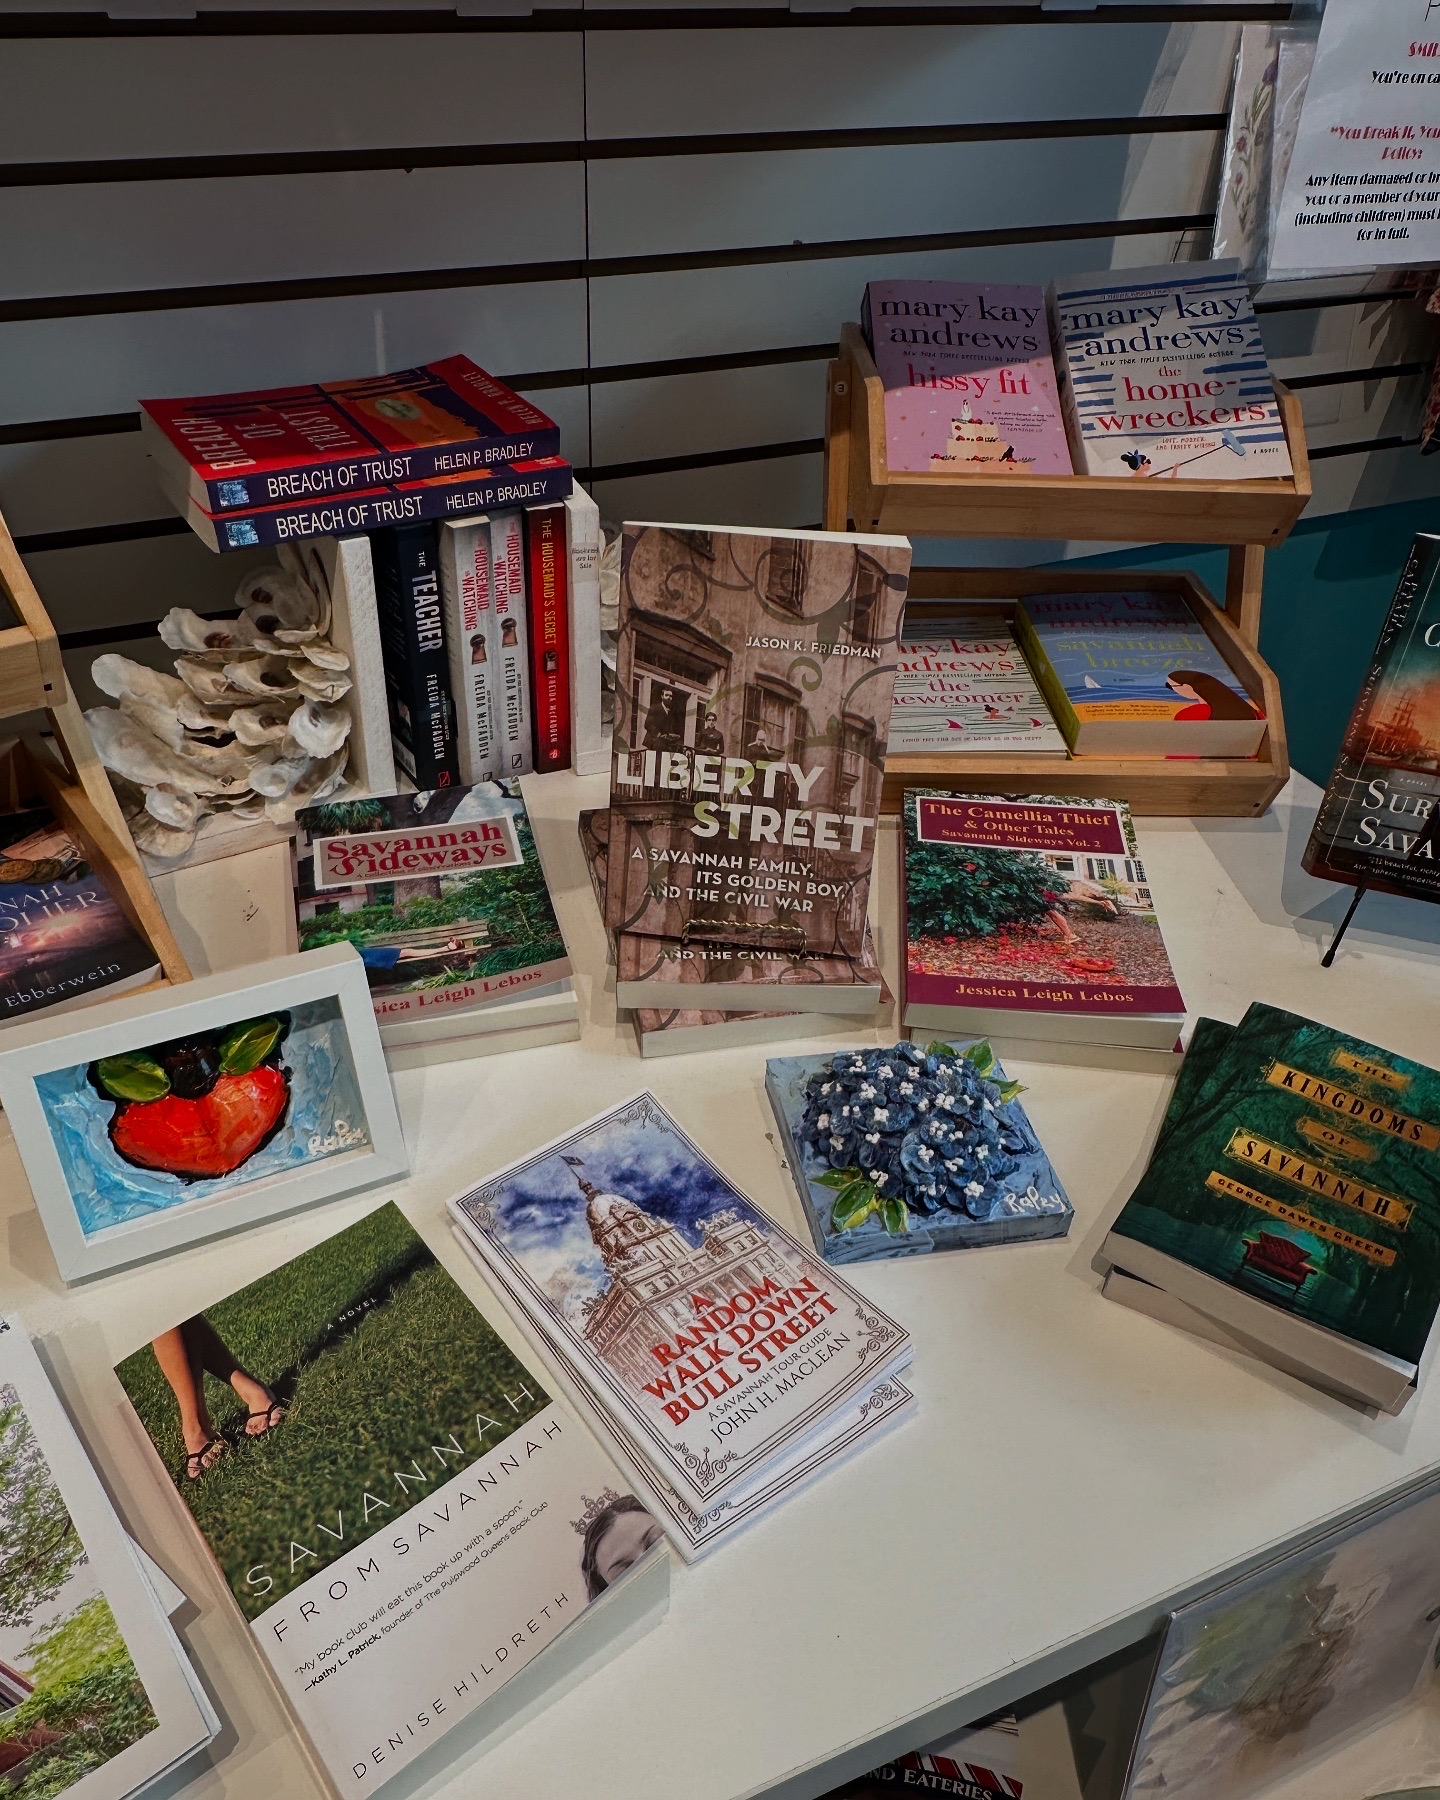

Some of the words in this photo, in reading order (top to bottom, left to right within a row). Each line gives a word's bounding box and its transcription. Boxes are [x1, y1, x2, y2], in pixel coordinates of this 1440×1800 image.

[1372, 71, 1409, 84] You're
[1411, 74, 1426, 83] on
[1363, 126, 1401, 139] Break
[1382, 147, 1423, 160] Policy:
[1305, 175, 1329, 187] Any
[1360, 172, 1413, 185] damaged
[1415, 173, 1427, 184] or
[1306, 195, 1326, 206] you
[1329, 194, 1341, 205] or
[1343, 194, 1350, 204] a
[1352, 191, 1402, 204] member
[1403, 190, 1415, 202] of
[1415, 191, 1440, 202] your
[1295, 211, 1353, 226] (including
[1354, 209, 1405, 222] children)
[1407, 207, 1435, 220] must
[1357, 228, 1373, 241] for
[1374, 227, 1386, 240] in
[1388, 227, 1410, 239] full.
[878, 299, 970, 323] mary
[977, 296, 1042, 328] kay
[1069, 305, 1167, 330] mary
[1172, 294, 1247, 320] kay
[890, 322, 1039, 351] andrews
[1085, 327, 1244, 357] andrews
[907, 363, 990, 399] hissy
[998, 369, 1032, 395] fit
[1158, 366, 1182, 377] the
[1122, 376, 1237, 402] home-
[234, 423, 286, 439] OF
[280, 409, 359, 450] TRUST
[1095, 401, 1266, 431] wreckers
[171, 416, 257, 470] BREACH
[267, 469, 334, 498] BREACH
[337, 465, 359, 486] OF
[362, 457, 412, 479] TRUST
[434, 452, 471, 471] HELEN
[473, 451, 482, 464] P.
[485, 442, 534, 462] BRADLEY
[276, 508, 345, 538] BREACH
[347, 505, 368, 526] OF
[372, 496, 423, 522] TRUST
[446, 492, 484, 511] HELEN
[486, 490, 495, 504] P.
[498, 481, 548, 502] BRADLEY
[542, 519, 552, 539] THE
[418, 551, 426, 567] THE
[506, 534, 521, 594] HOUSEMAID
[541, 542, 555, 607] HOUSEMAID'S
[474, 549, 490, 611] HOUSEMAID
[494, 560, 509, 615] WATCHING
[412, 570, 443, 653] TEACHER
[462, 576, 477, 631] WATCHING
[544, 611, 557, 645] SECRET
[745, 636, 790, 651] JASON
[794, 640, 807, 652] K.
[811, 642, 882, 659] FRIEDMAN
[897, 655, 1015, 672] ndrews
[950, 639, 1011, 656] kay
[426, 673, 439, 708] FREIDA
[474, 673, 487, 708] FREIDA
[504, 657, 517, 690] FREIDA
[927, 679, 970, 692] the
[892, 692, 1024, 705] newcomer
[506, 694, 519, 741] McFADDEN
[431, 712, 445, 760] McFADDEN
[477, 711, 489, 760] McFADDEN
[616, 749, 825, 802] LIBERTY
[690, 801, 875, 853] STREET
[925, 803, 963, 816] The
[967, 807, 1053, 823] Camellia
[1057, 812, 1111, 826] Thief
[963, 820, 978, 829] &
[983, 821, 1030, 833] Other
[1033, 824, 1075, 836] Tales
[327, 822, 504, 861] Savannah
[941, 829, 1001, 841] Savannah
[1006, 835, 1064, 847] Sideways
[1066, 838, 1091, 847] Vol.
[329, 842, 507, 876] Sideways
[631, 847, 644, 859] A
[649, 848, 743, 869] SAVANNAH
[749, 858, 814, 879] FAMILY,
[644, 884, 681, 898] AND
[686, 887, 719, 903] THE
[724, 891, 770, 908] CIVIL
[775, 896, 814, 913] WAR
[697, 871, 722, 885] ITS
[727, 874, 800, 893] GOLDEN
[806, 882, 847, 898] BOY,
[657, 949, 695, 960] AND
[699, 951, 732, 960] THE
[737, 951, 783, 960] CIVIL
[5, 963, 121, 1007] Ebberwein
[373, 1000, 411, 1015] sica
[418, 985, 475, 1007] Leigh
[484, 969, 542, 993] Lebos
[955, 984, 1017, 998] Jessica
[1022, 988, 1074, 1002] Leigh
[1080, 990, 1134, 1002] Lebos
[1351, 1059, 1393, 1083] THE
[1282, 1070, 1423, 1141] KINGDOMS
[1322, 1131, 1351, 1147] OF
[1242, 1140, 1391, 1217] SAVANNAH
[1218, 1178, 1273, 1208] GEORGE
[1278, 1206, 1327, 1233] DAWES
[1333, 1231, 1384, 1257] GREEN
[327, 1323, 334, 1331] A
[339, 1297, 378, 1322] NOVEL
[690, 1292, 716, 1315] A
[642, 1338, 735, 1401] WALK
[726, 1276, 821, 1348] DOWN
[650, 1275, 782, 1368] RANDOM
[661, 1367, 744, 1427] BULL
[737, 1292, 838, 1374] STREET
[708, 1411, 718, 1421] A
[716, 1372, 773, 1415] SAVANNAH
[770, 1352, 801, 1375] TOUR
[799, 1327, 832, 1354] GUIDE
[710, 1402, 759, 1444] JOHN
[756, 1391, 778, 1408] H.
[775, 1332, 851, 1395] MACLEAN
[245, 1381, 537, 1599] SAVANNAH
[272, 1557, 383, 1642] FROM
[393, 1419, 562, 1556] SAVANNAH
[316, 1638, 345, 1661] book
[345, 1621, 368, 1640] club
[368, 1606, 386, 1622] will
[387, 1595, 405, 1610] eat
[404, 1581, 423, 1597] this
[423, 1561, 450, 1583] book
[449, 1551, 463, 1564] up
[464, 1534, 485, 1553] with
[485, 1528, 492, 1536] a
[348, 1633, 382, 1659] Patrick,
[380, 1607, 414, 1635] founder
[415, 1599, 424, 1610] of
[423, 1588, 441, 1602] The
[440, 1556, 481, 1590] Pulpwood
[480, 1534, 510, 1558] Queens
[509, 1516, 531, 1535] Book
[530, 1501, 549, 1518] Club
[352, 1698, 447, 1779] DENISE
[453, 1592, 569, 1697] HILDRETH
[904, 1768, 993, 1800] EATERIES
